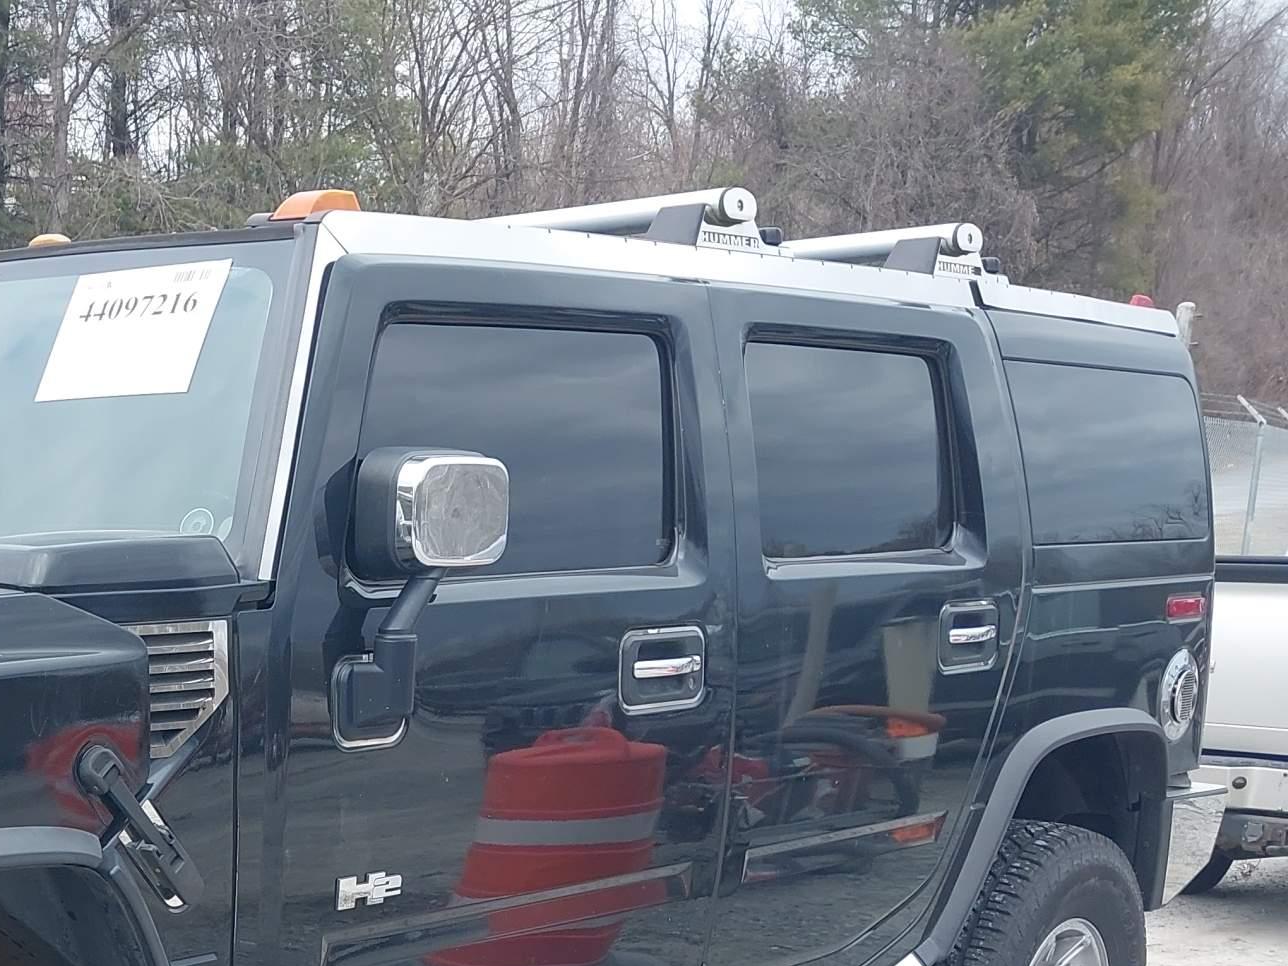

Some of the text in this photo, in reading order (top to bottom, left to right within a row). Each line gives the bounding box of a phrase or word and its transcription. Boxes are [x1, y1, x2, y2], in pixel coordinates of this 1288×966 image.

[702, 230, 759, 248] HUMMER
[79, 291, 198, 322] 44097216
[335, 871, 402, 911] H2
